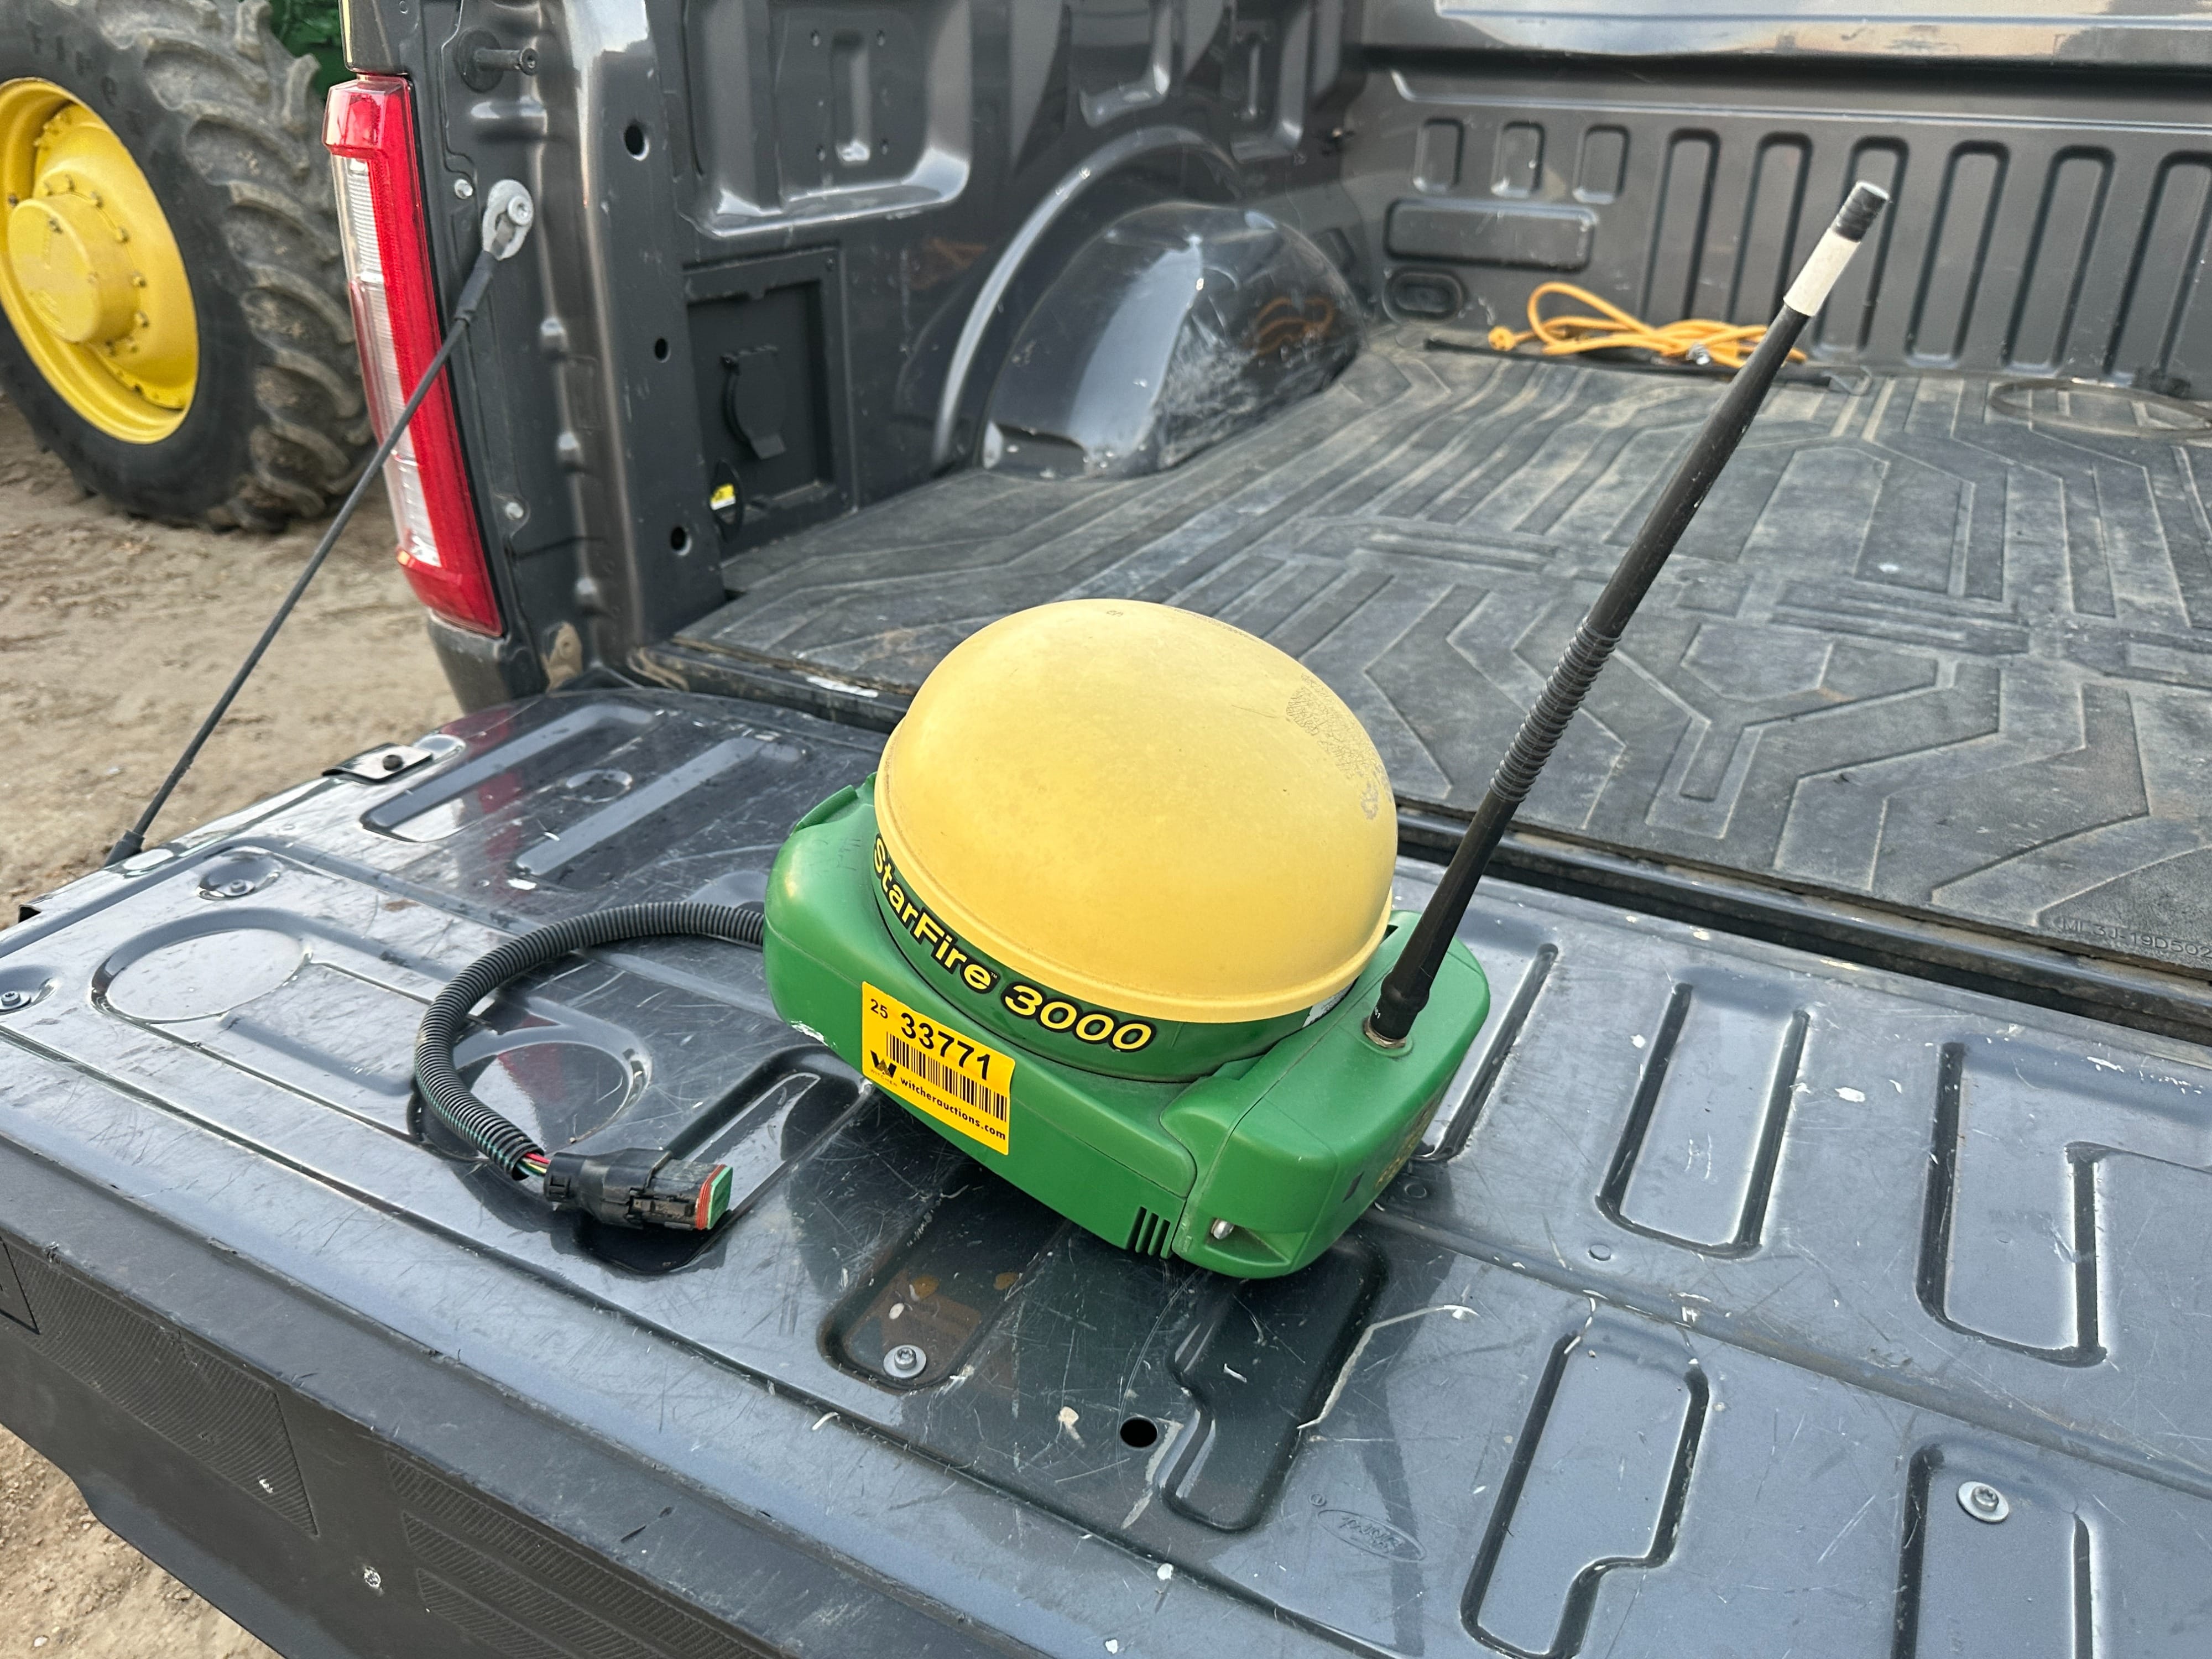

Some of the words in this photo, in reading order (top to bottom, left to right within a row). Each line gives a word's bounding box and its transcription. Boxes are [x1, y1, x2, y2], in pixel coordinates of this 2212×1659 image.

[870, 998, 888, 1019] 25
[901, 1013, 990, 1081] 33771
[1004, 984, 1152, 1050] 3000
[900, 1077, 1006, 1140] witcherauctions.com
